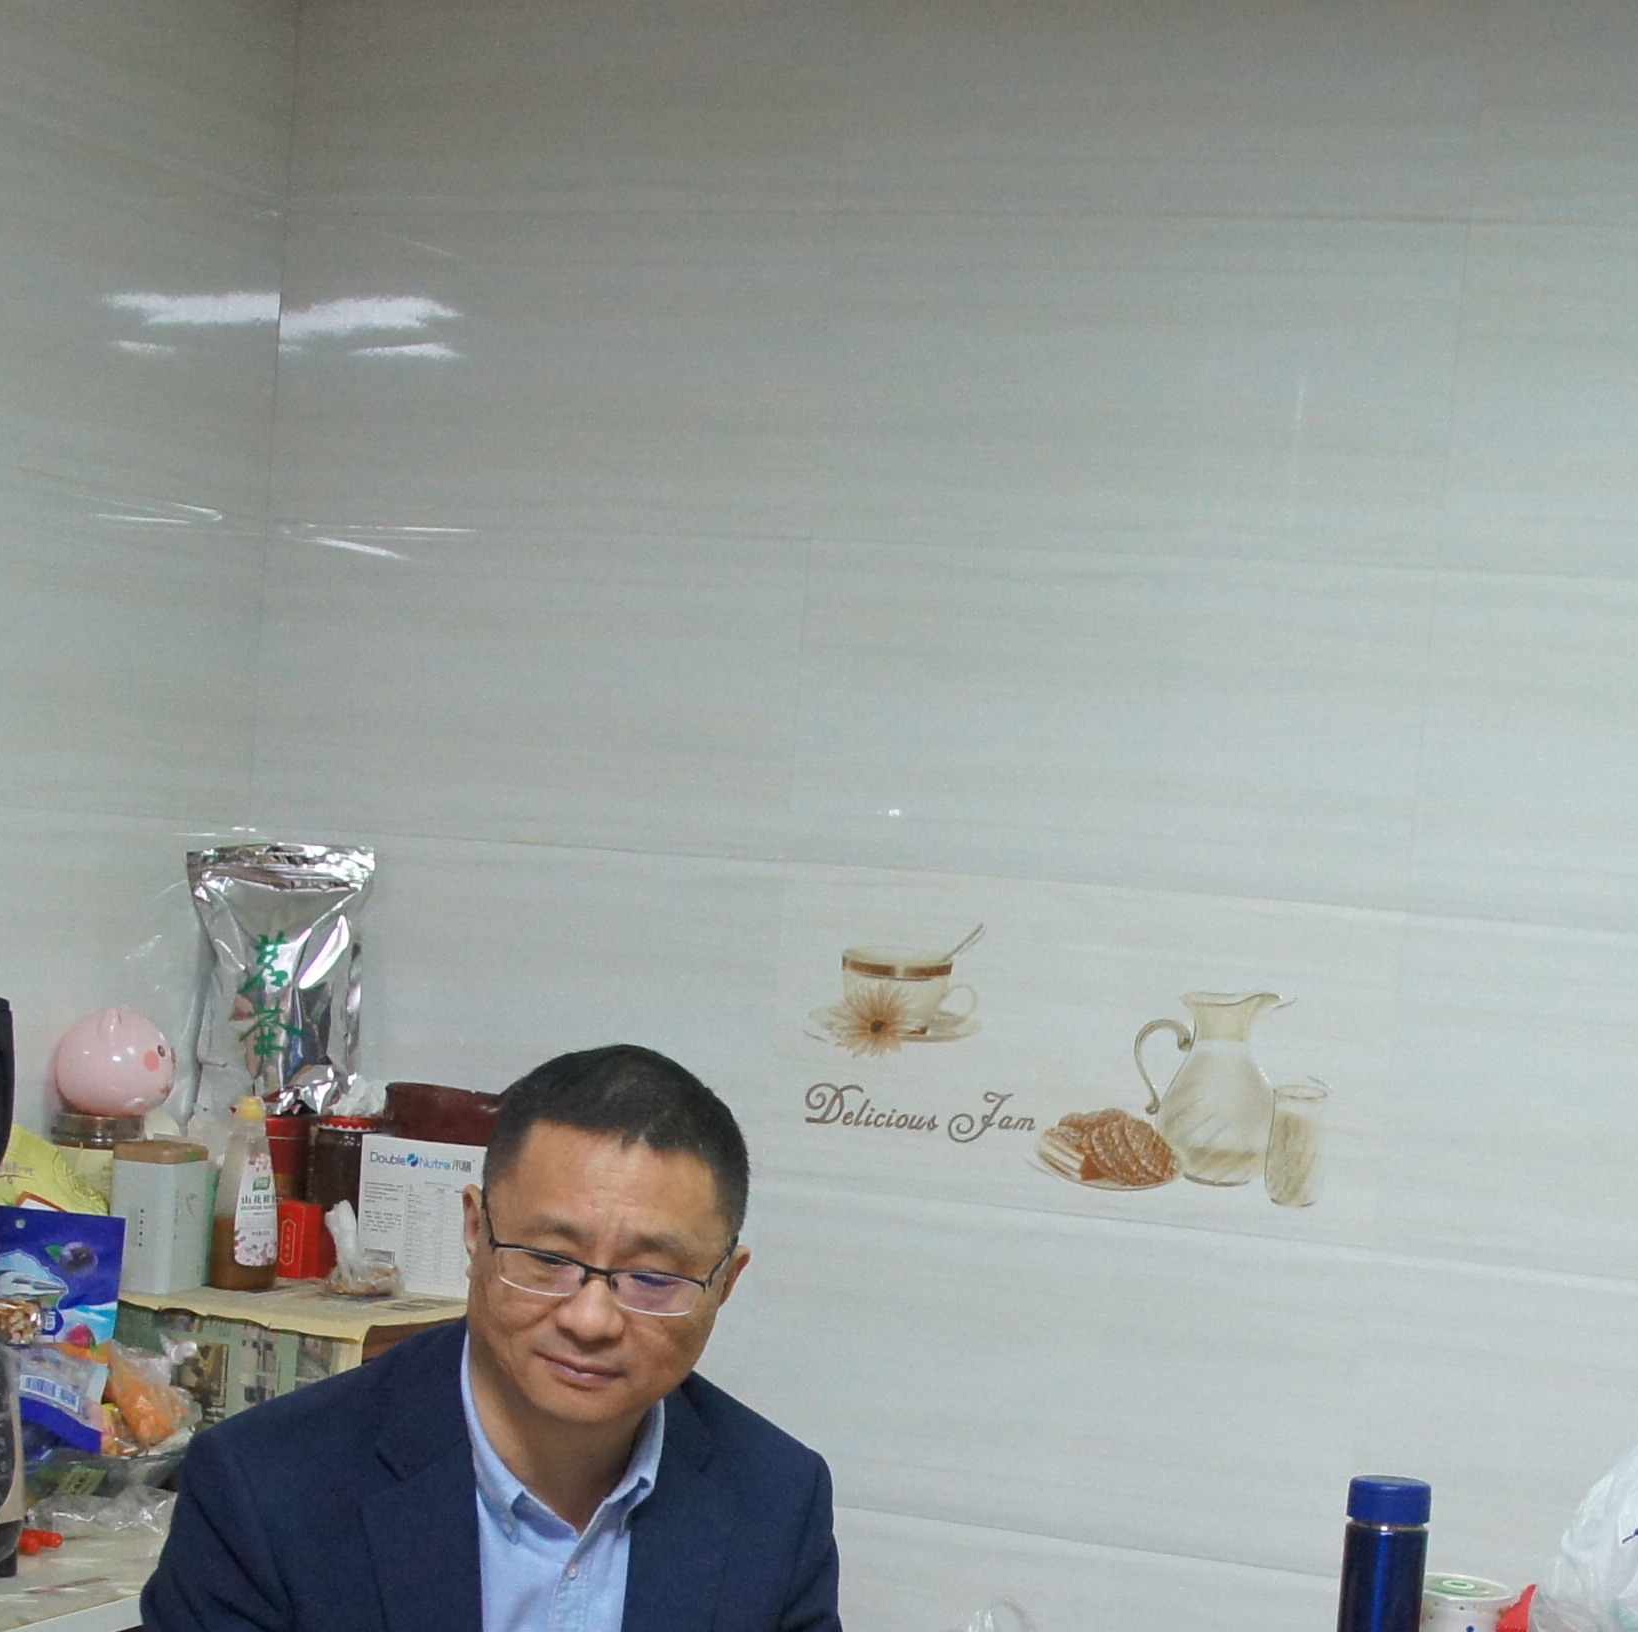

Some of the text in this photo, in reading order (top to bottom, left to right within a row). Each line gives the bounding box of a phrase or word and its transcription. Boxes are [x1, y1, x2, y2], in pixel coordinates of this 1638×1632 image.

[803, 1082, 1036, 1143] Delicious Jam
[369, 1151, 406, 1166] Double
